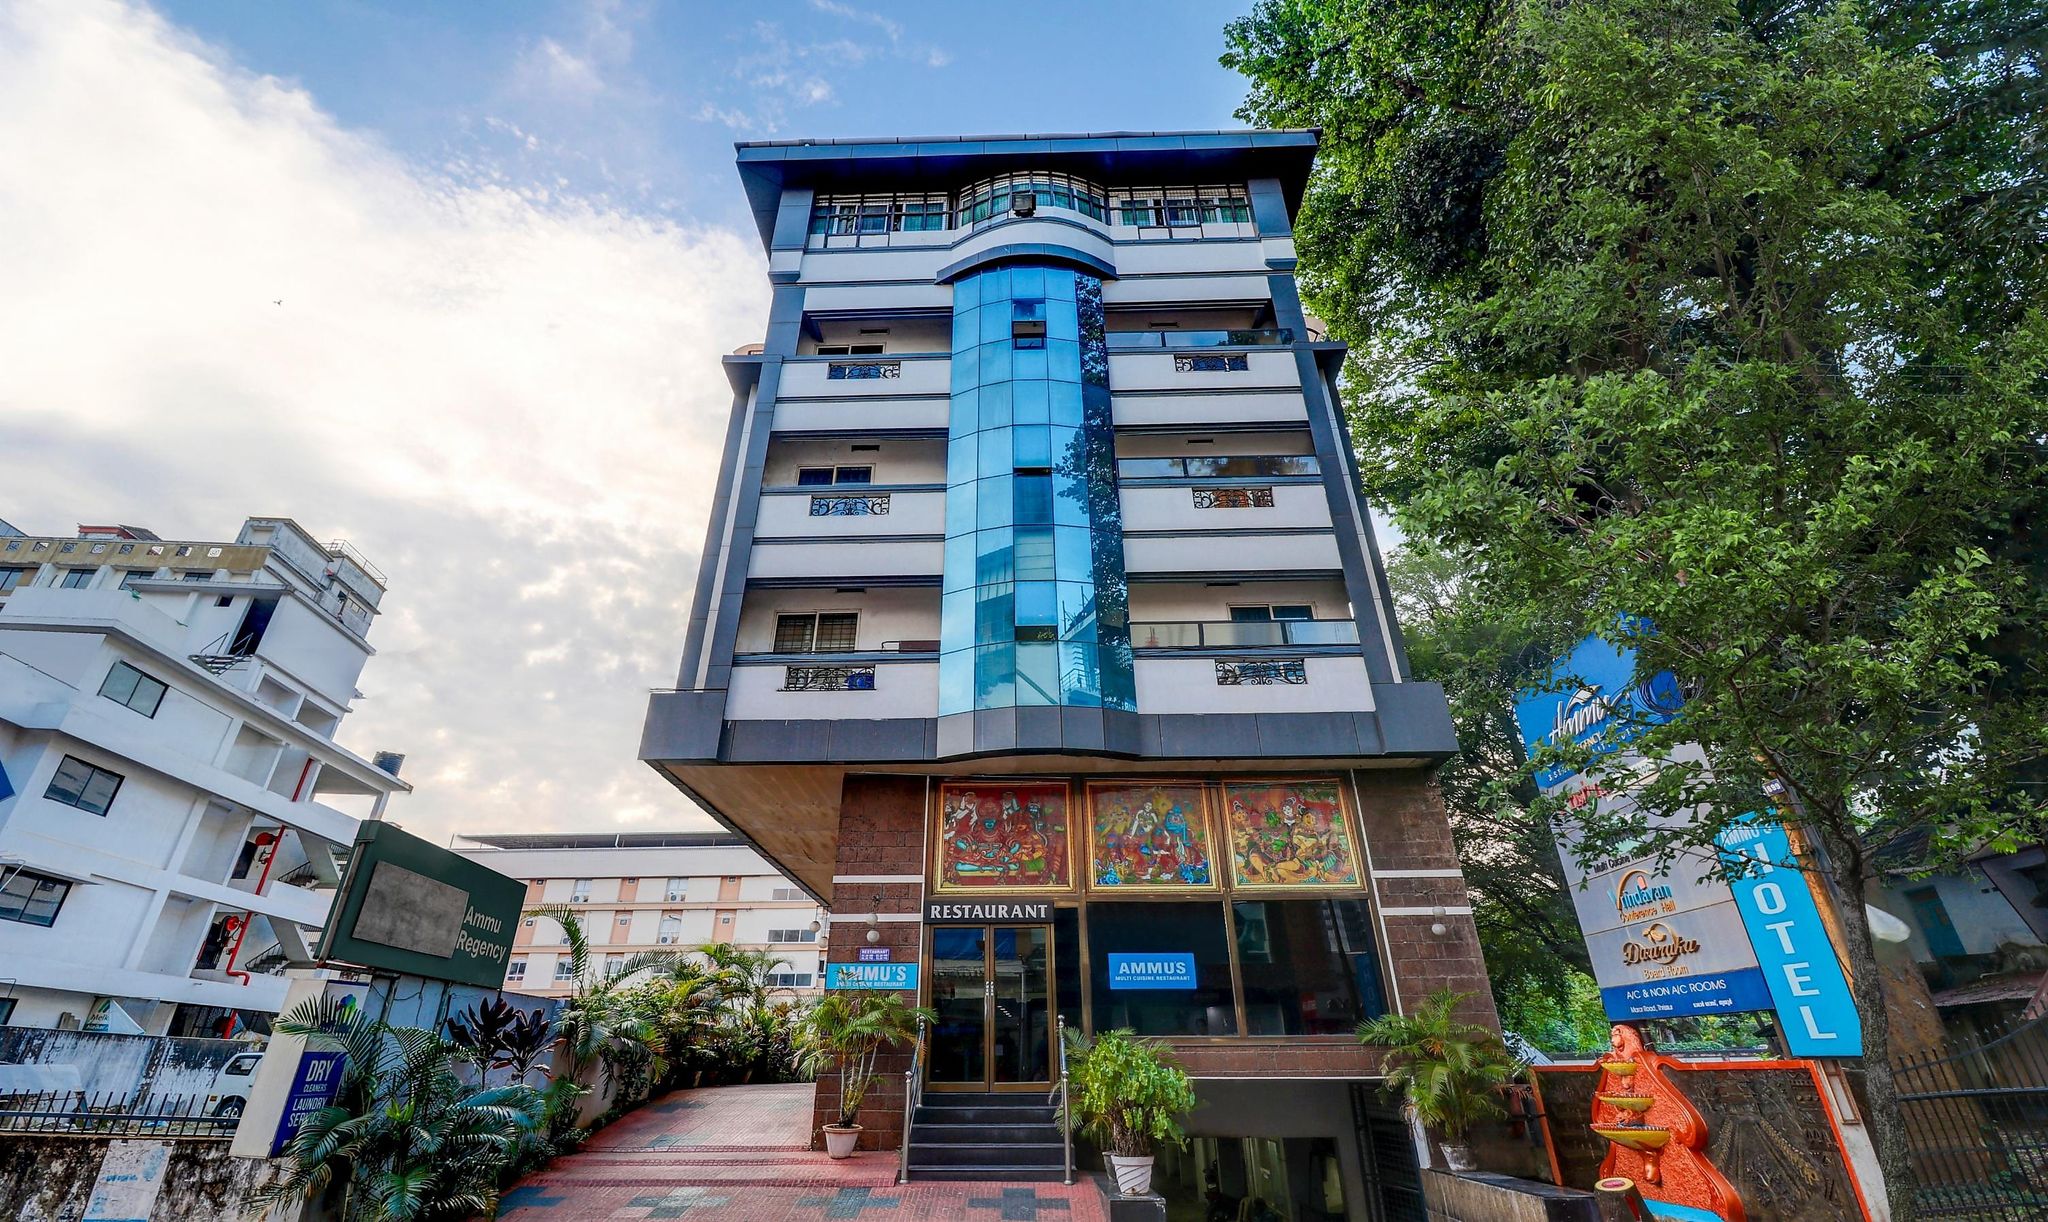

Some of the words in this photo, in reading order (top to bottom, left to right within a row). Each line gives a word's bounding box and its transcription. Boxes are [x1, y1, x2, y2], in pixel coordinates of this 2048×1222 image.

[463, 905, 502, 934] Ammu
[929, 904, 1048, 919] RESTAURANT
[1620, 907, 1658, 923] Conference
[1661, 900, 1676, 914] Hall
[456, 929, 507, 964] Regency
[1736, 842, 1838, 1040] HOTEL
[1119, 961, 1186, 974] AMMU'S
[1643, 967, 1665, 980] Board
[1667, 965, 1690, 977] Room
[1626, 990, 1641, 1000] A/C
[1643, 989, 1649, 998] &
[1650, 987, 1670, 997] NON
[1672, 985, 1688, 995] A/C
[1689, 979, 1727, 993] ROOMS
[305, 1059, 335, 1082] DRY
[303, 1083, 328, 1093] CLEANERS
[292, 1097, 328, 1111] LAUNDRY
